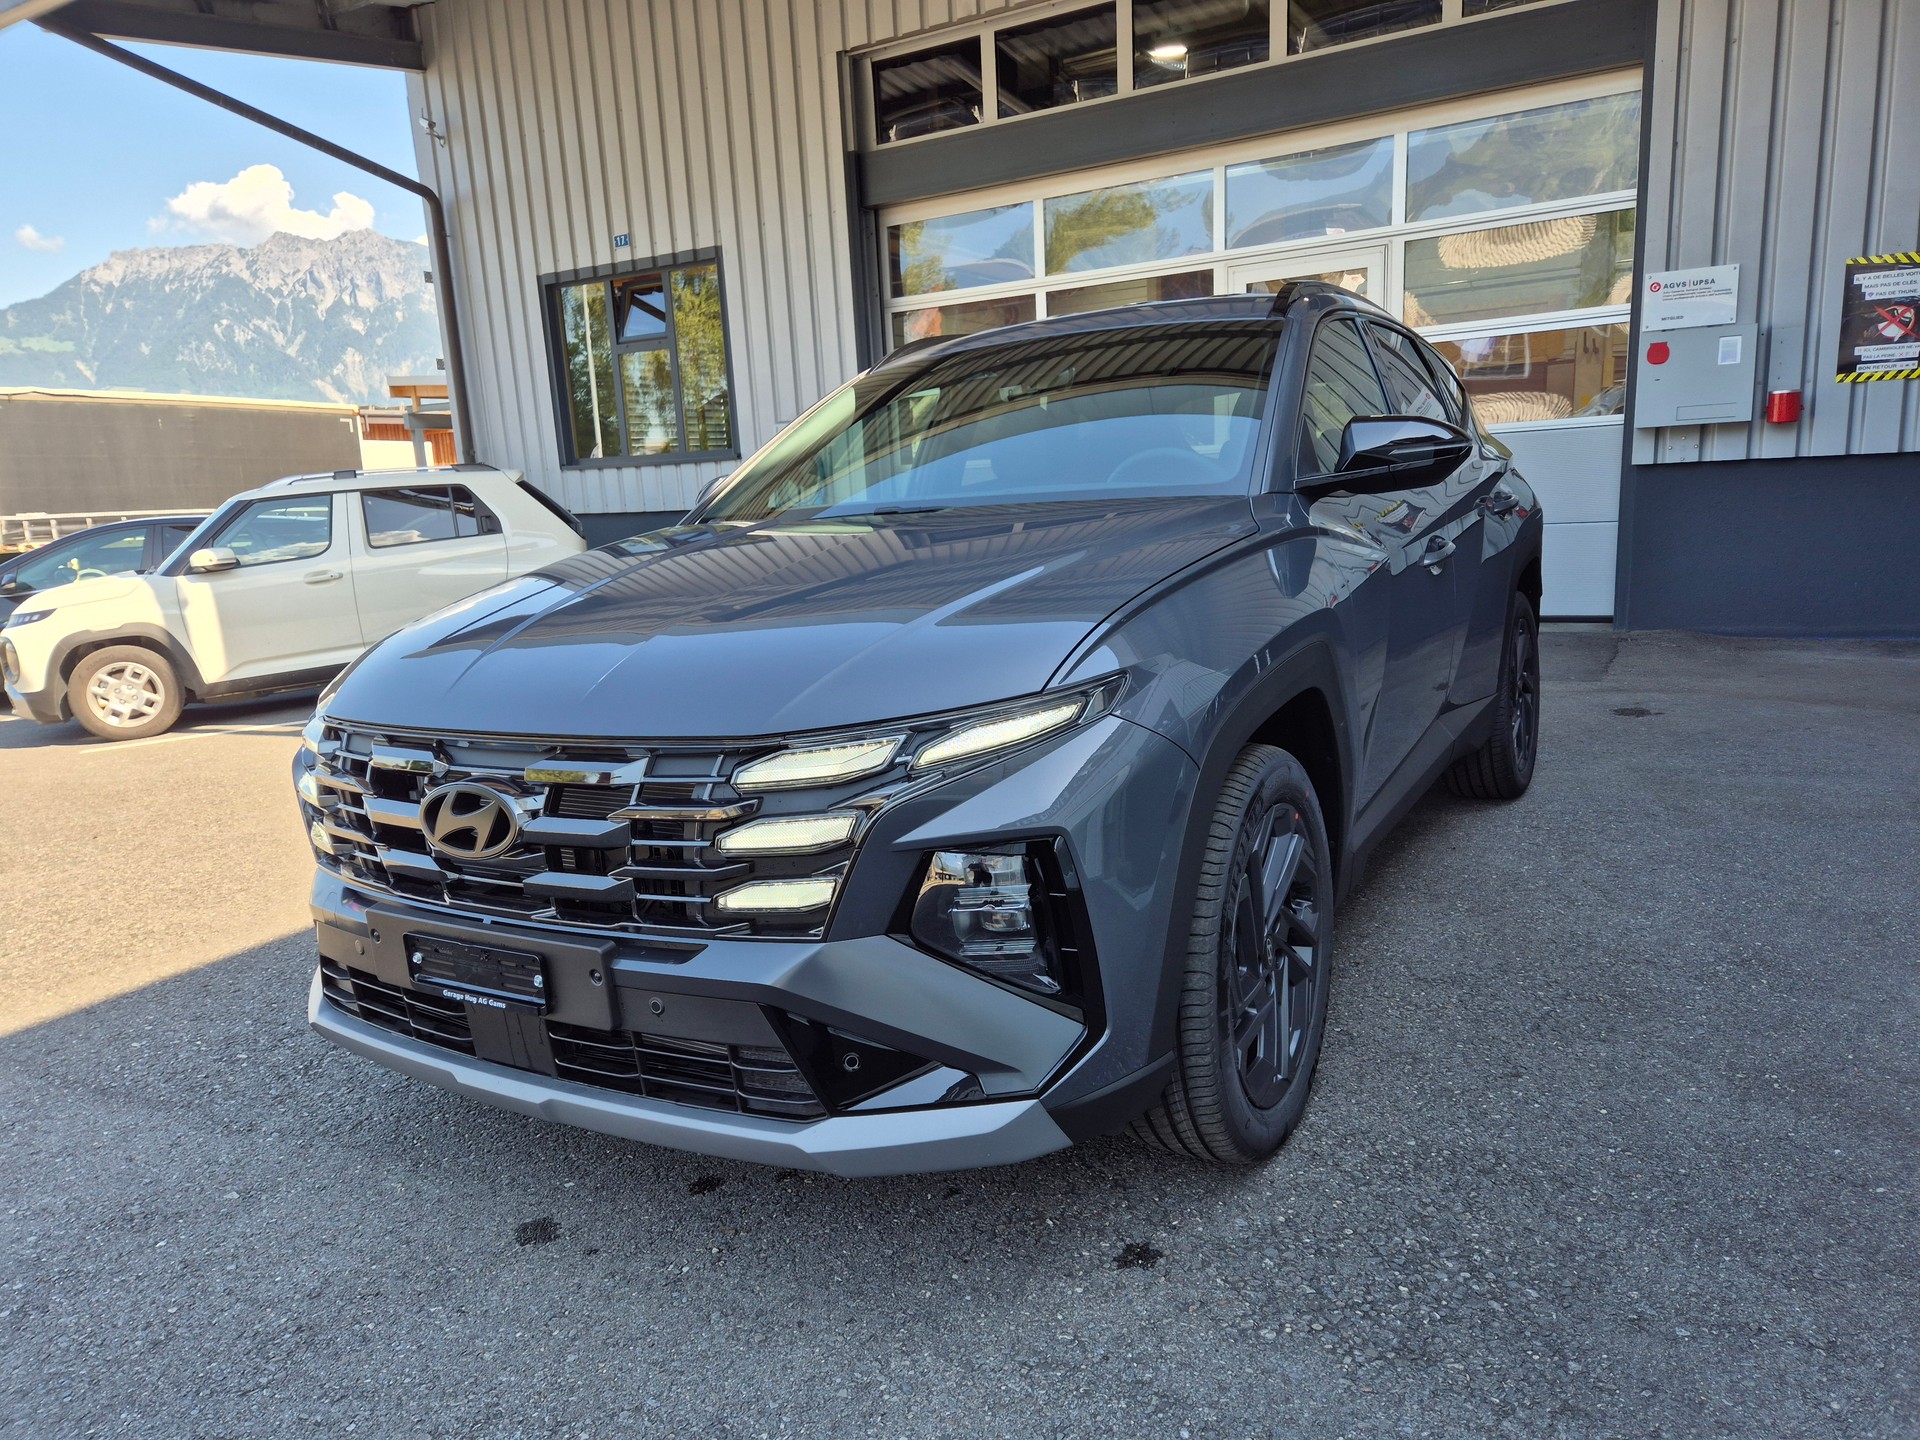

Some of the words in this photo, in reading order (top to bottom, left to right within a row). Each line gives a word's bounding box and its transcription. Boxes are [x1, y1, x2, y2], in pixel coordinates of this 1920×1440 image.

[616, 235, 625, 246] 17
[1663, 281, 1687, 289] AGVS
[1692, 278, 1716, 286] UPSA
[442, 989, 464, 1000] Garage
[488, 999, 506, 1009] Gams
